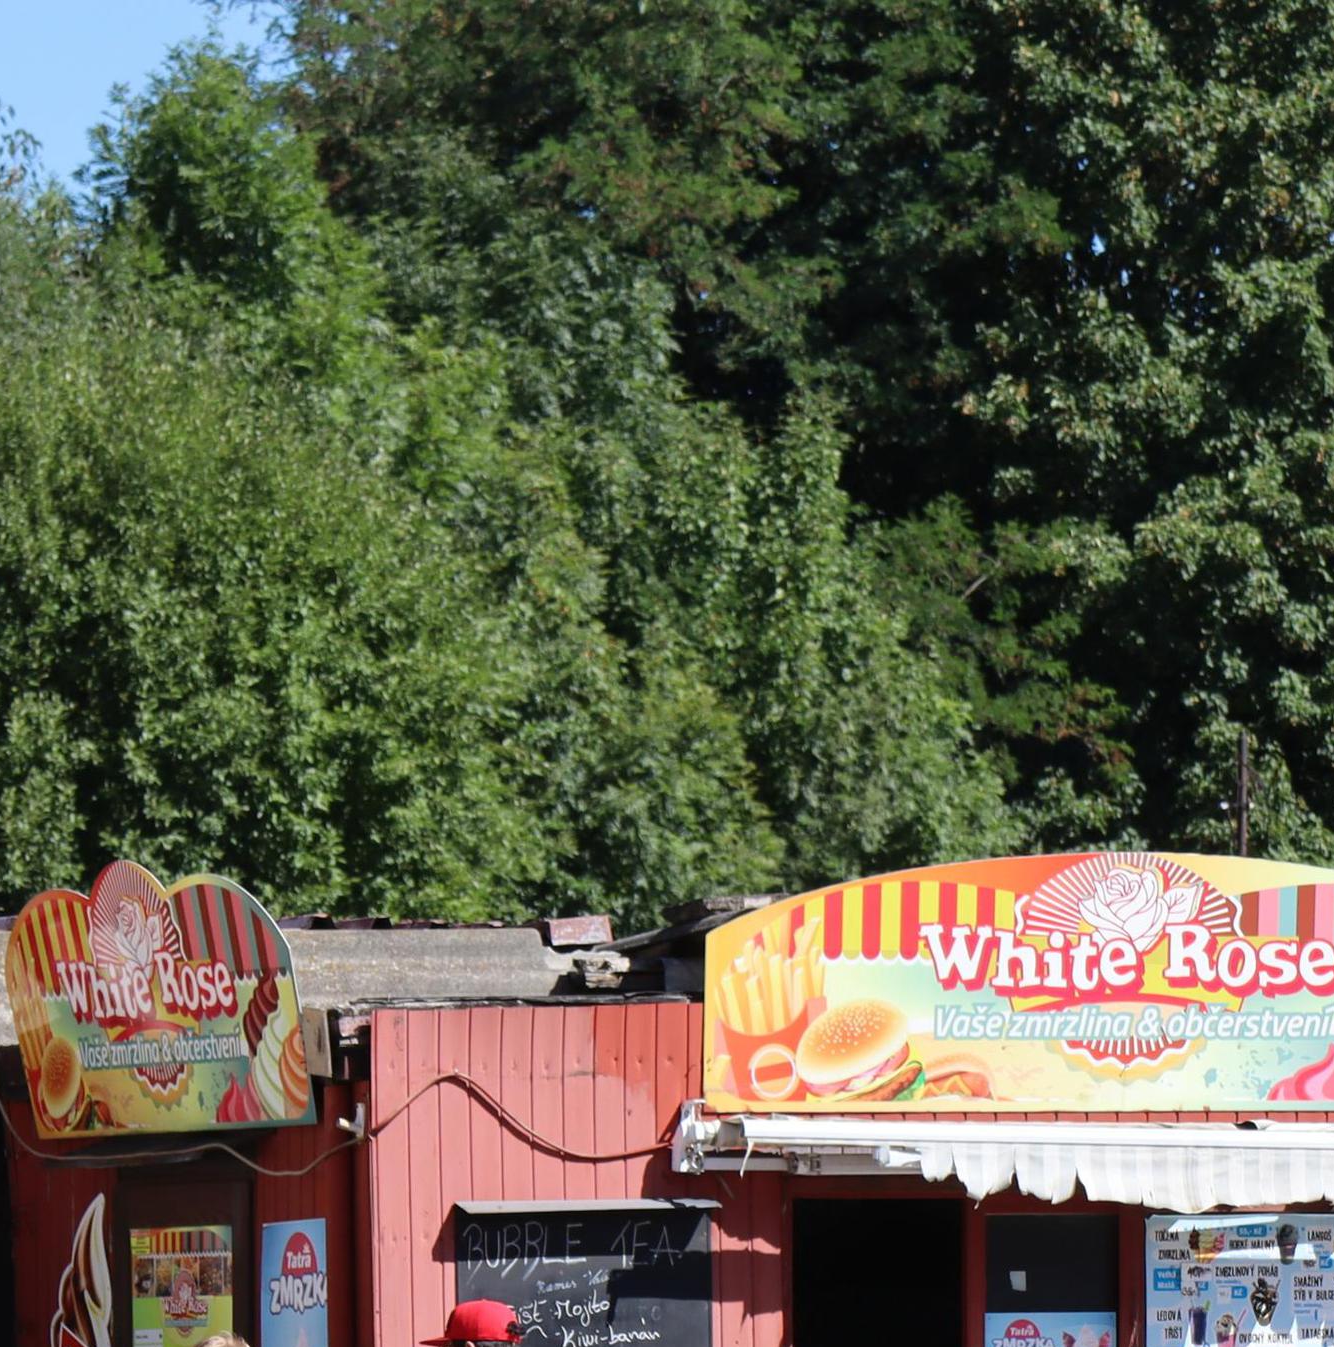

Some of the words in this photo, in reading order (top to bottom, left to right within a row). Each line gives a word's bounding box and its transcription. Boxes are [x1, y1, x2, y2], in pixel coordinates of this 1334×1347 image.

[920, 921, 1144, 991] White
[56, 960, 154, 1020] White
[153, 951, 236, 1010] Rose
[935, 1004, 1003, 1038] Vaše
[1007, 1004, 1132, 1038] zmrzlina
[1136, 1009, 1160, 1038] &
[1163, 1003, 1334, 1038] občerstvení
[79, 1035, 109, 1068] Vaše
[109, 1034, 160, 1066] zmrzlina
[162, 1040, 172, 1061] &
[174, 1027, 242, 1061] občerstvení
[286, 1249, 312, 1270] Tatra
[463, 1221, 587, 1284] BUBBLE
[611, 1220, 683, 1268] TEA
[1009, 1326, 1035, 1336] Tatra
